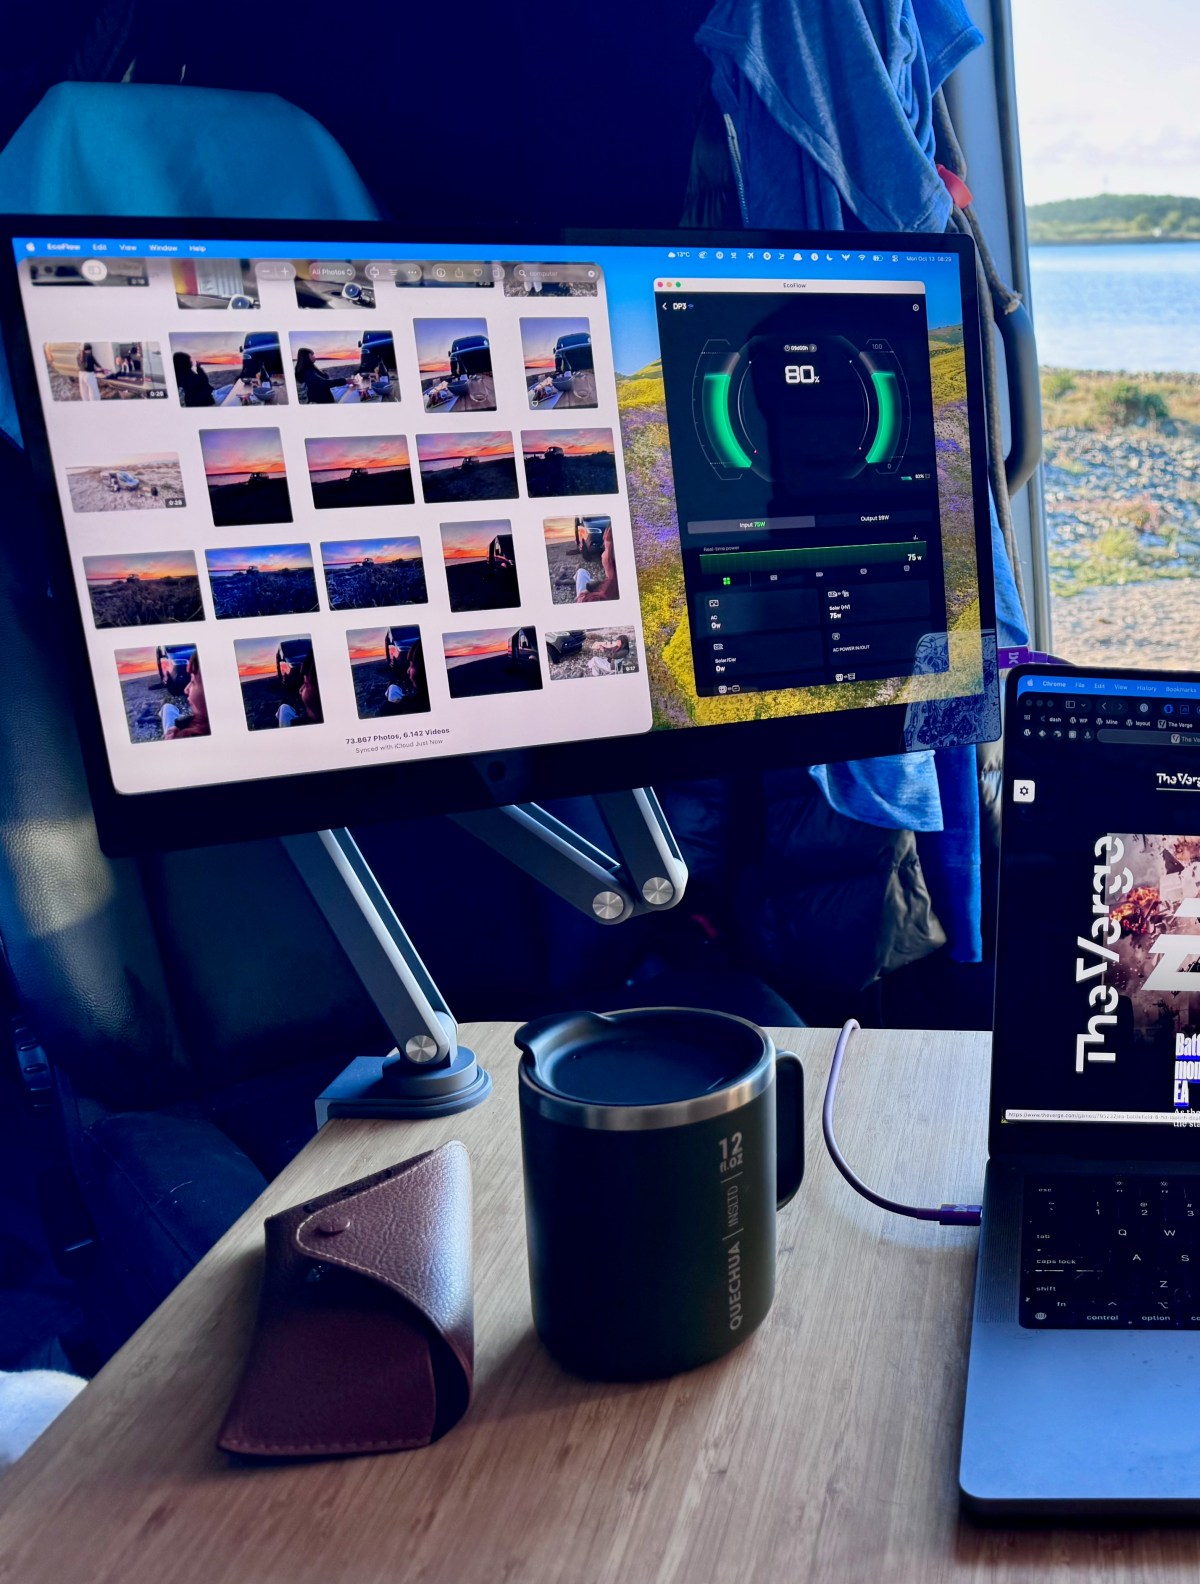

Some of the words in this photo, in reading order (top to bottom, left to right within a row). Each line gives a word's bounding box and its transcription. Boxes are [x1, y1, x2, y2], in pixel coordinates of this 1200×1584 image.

[312, 268, 320, 276] All
[322, 268, 346, 276] Photos
[672, 302, 687, 310] DP3
[740, 522, 753, 530] Input
[1042, 680, 1066, 688] Chrome
[1166, 686, 1197, 694] Bookmarks
[374, 732, 402, 743] Photos,
[425, 728, 450, 736] Videos
[355, 745, 378, 754] Synced
[429, 738, 444, 746] Now
[1174, 1080, 1189, 1103] EA
[718, 1131, 744, 1160] 12
[1118, 1228, 1128, 1236] Q
[1132, 1254, 1142, 1262] A
[1180, 1254, 1190, 1262] S
[728, 1241, 742, 1330] QUECHUA
[1142, 1314, 1170, 1322] option
